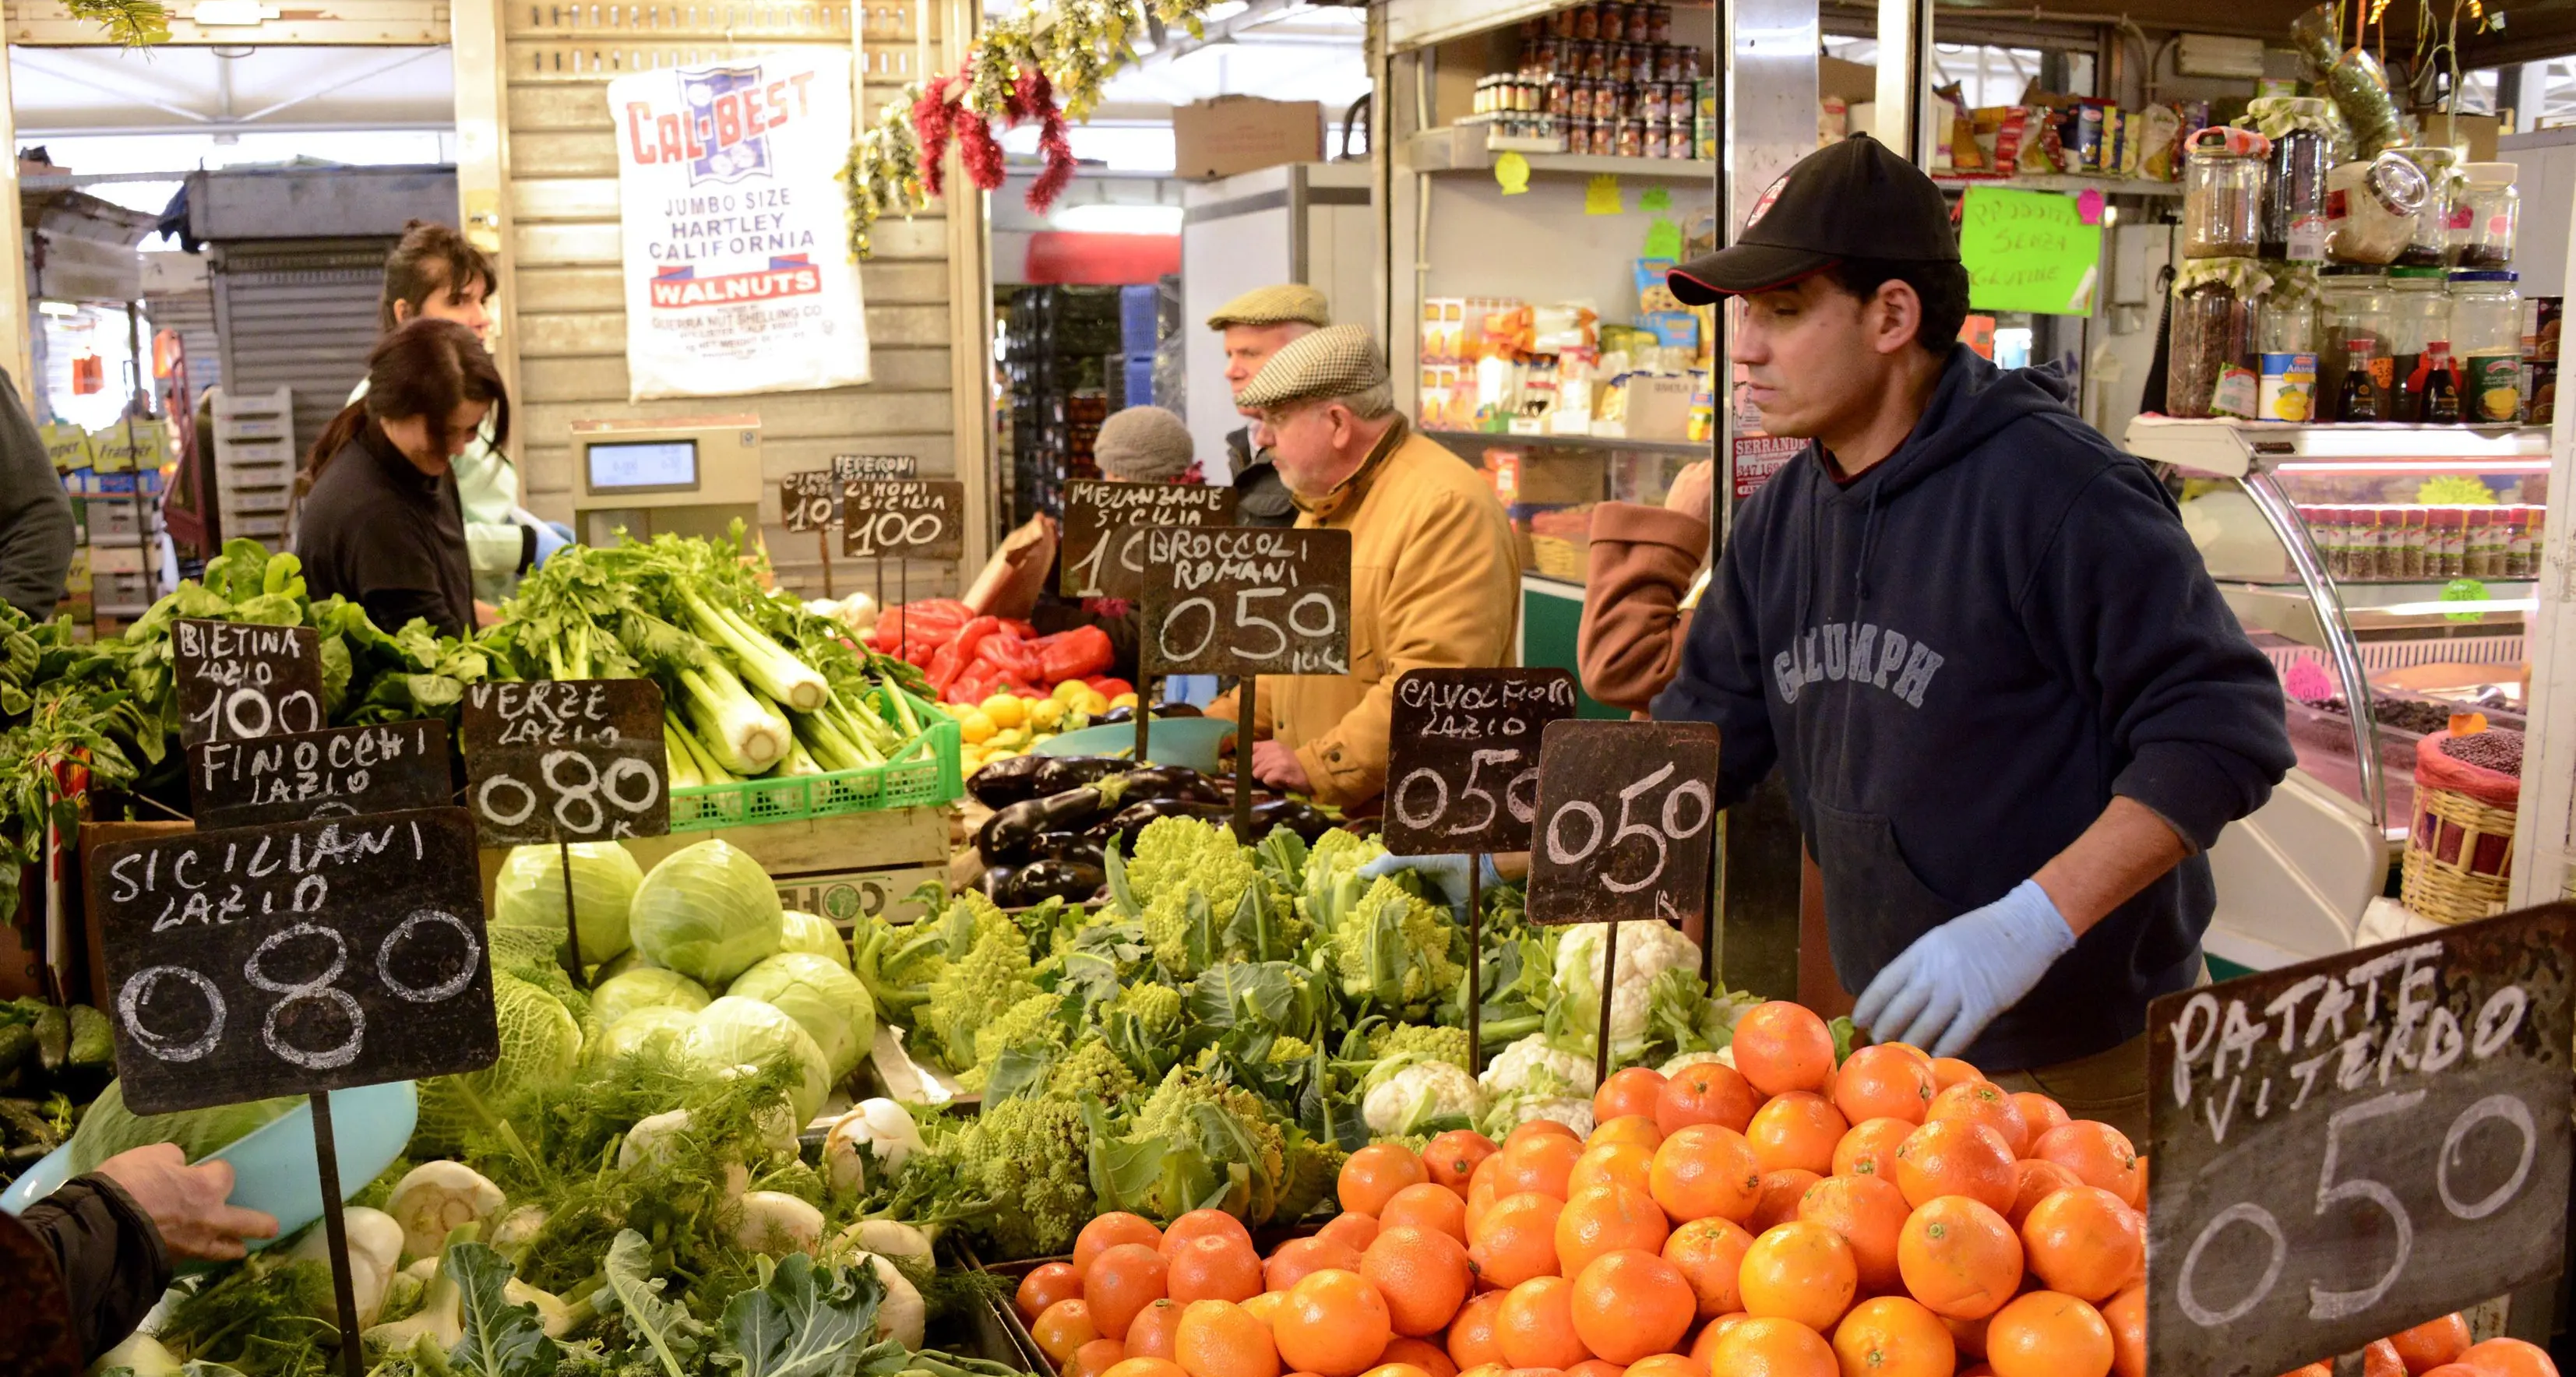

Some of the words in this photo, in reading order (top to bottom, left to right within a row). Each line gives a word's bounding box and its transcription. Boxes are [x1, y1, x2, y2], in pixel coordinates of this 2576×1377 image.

[664, 192, 735, 217] JUMBO
[745, 188, 791, 210] SIZE
[671, 213, 784, 239] HARTLEY
[649, 229, 815, 260] CALIFORNIA
[654, 269, 816, 305] WALNUTS
[844, 482, 928, 498] LIMONI
[858, 495, 945, 511] SICILIA
[1071, 484, 1224, 511] MELANZANE
[848, 512, 943, 556] 100
[1094, 507, 1201, 528] SICILIA
[1148, 530, 1307, 564] BROCCOLI
[1173, 560, 1299, 590] ROMANI
[179, 622, 301, 659] BIETINA
[1159, 587, 1335, 662] 050
[195, 659, 273, 688] LAZIO
[189, 688, 319, 742] 100
[471, 680, 608, 721] VERZE
[1422, 711, 1527, 739] LAZIO
[251, 770, 370, 805] LAZIO
[478, 749, 659, 833] 080
[1545, 762, 1711, 894] 050
[110, 821, 423, 902] SICILIANI
[152, 874, 328, 932] LAZIO
[118, 909, 481, 1070] 080
[2170, 940, 2443, 1108] PATATE
[2177, 1090, 2536, 1327] 050
